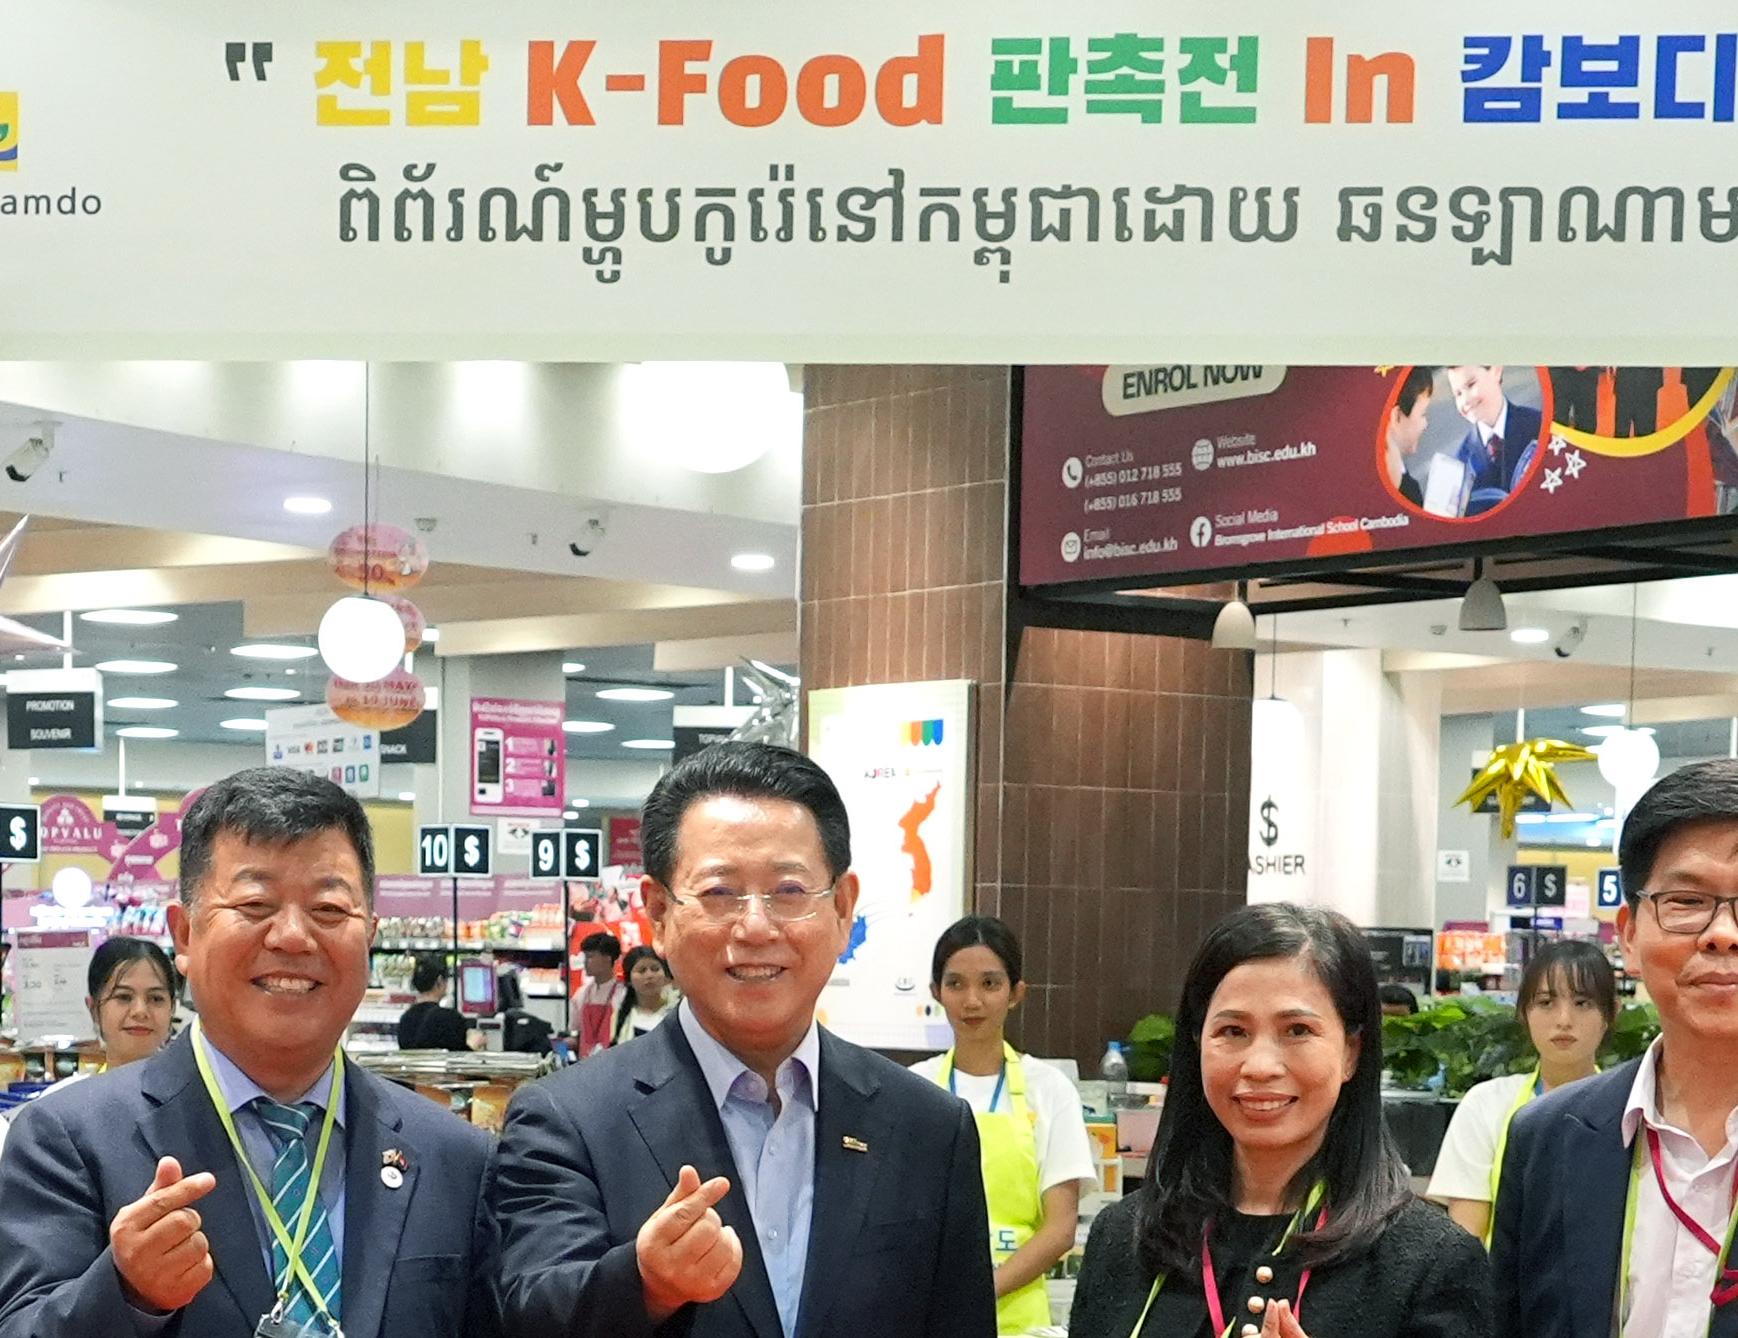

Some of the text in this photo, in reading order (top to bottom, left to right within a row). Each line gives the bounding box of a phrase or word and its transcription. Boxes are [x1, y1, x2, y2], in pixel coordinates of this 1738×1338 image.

[313, 39, 489, 127] 전남
[527, 33, 945, 128] K-Food
[990, 33, 1259, 125] 판촉전
[1304, 36, 1416, 124] In
[1123, 365, 1197, 400] ENROL
[1216, 433, 1256, 449] Website
[1085, 452, 1119, 467] Contact
[1217, 441, 1317, 469] www.bisc.edu.kh
[1140, 465, 1160, 480] 718
[1140, 490, 1160, 504] 718
[1215, 508, 1279, 527] Social Media
[1326, 519, 1359, 535] School
[1360, 513, 1410, 530] Cambodia
[26, 700, 74, 712] PROMOTION
[10, 814, 27, 851] $
[1259, 795, 1279, 847] $
[421, 834, 480, 868] 10 $
[538, 838, 591, 871] 9 $
[1248, 855, 1305, 875] SHIER
[1512, 872, 1558, 899] 6 $
[1602, 875, 1618, 902] 5
